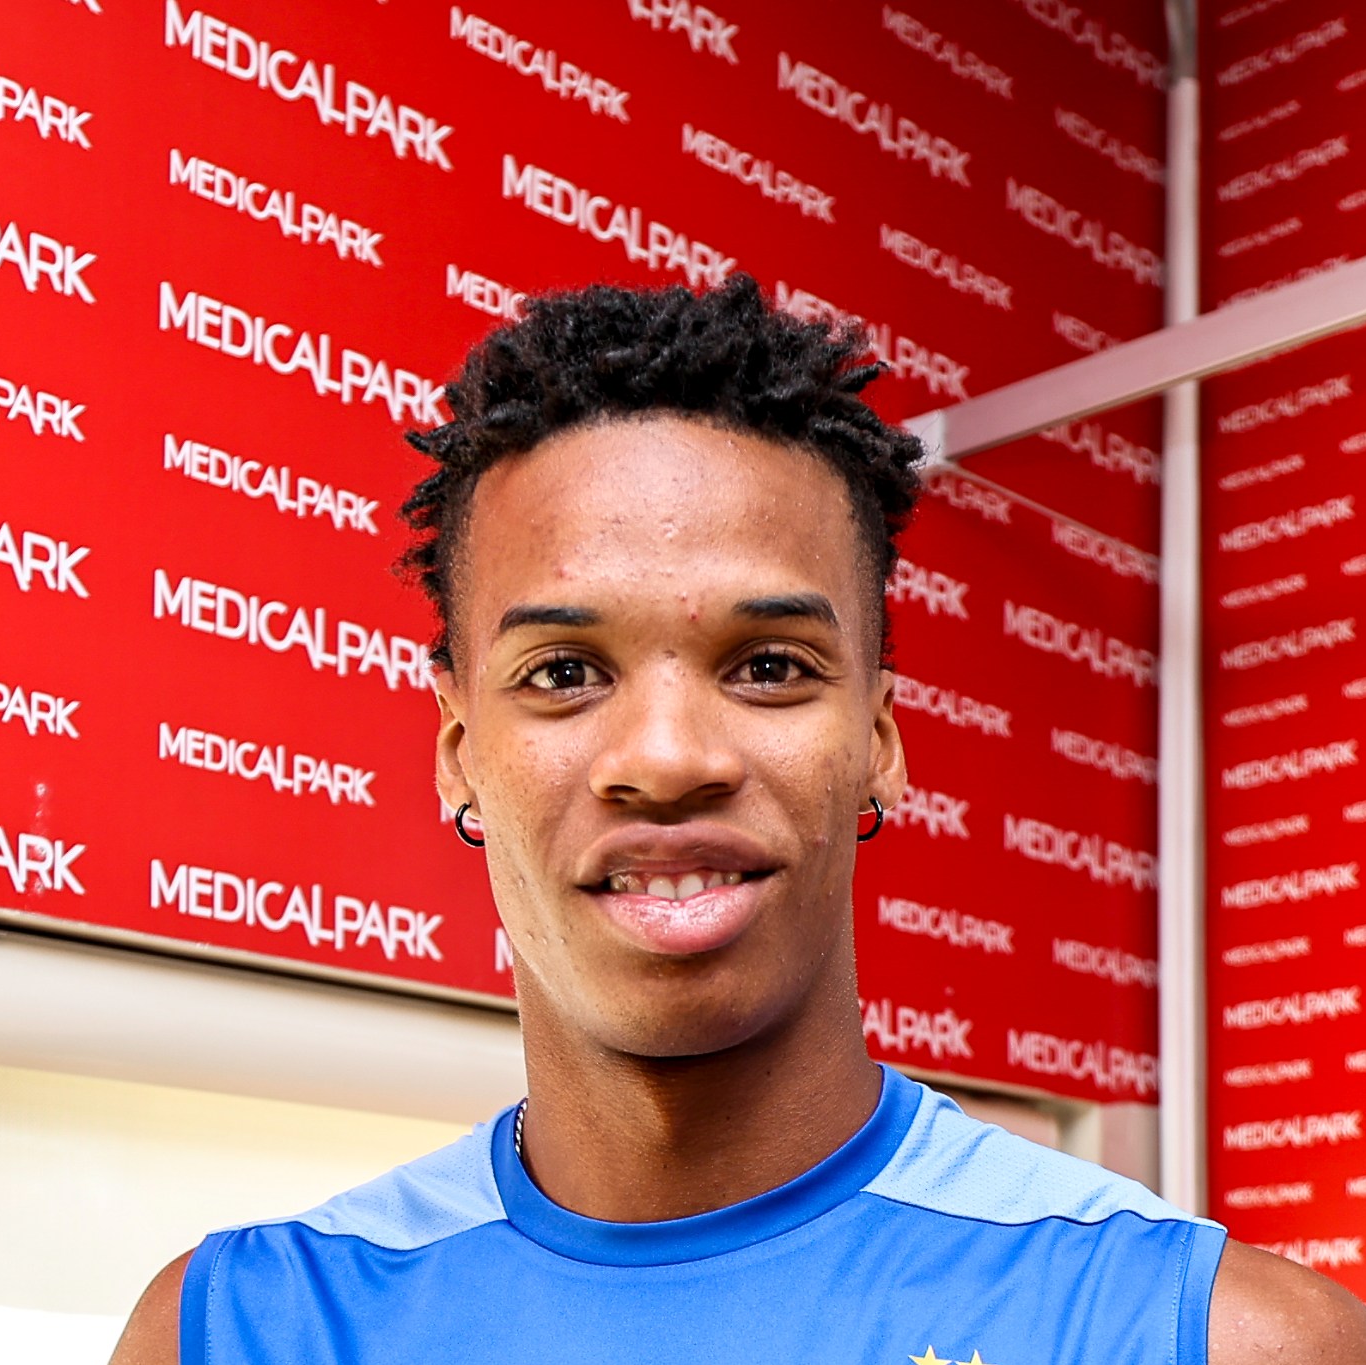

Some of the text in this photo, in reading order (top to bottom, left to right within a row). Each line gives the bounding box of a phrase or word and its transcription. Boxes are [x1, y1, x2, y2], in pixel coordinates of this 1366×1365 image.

[164, 0, 453, 171] MEDICALPARK
[449, 6, 630, 122] MEDICALPARK
[777, 51, 970, 187] MEDICALPARK
[169, 148, 383, 266] MEDICALPARK
[681, 122, 835, 224] MEDICALPARK
[159, 282, 448, 428] MEDICALPARK
[163, 433, 379, 535] MEDICALPARK
[893, 673, 1012, 739] EDICALPARK
[159, 722, 375, 806] MEDICALPARK
[150, 859, 443, 961] MEDICALPARK
[877, 895, 1014, 954] MEDICALPARK
[859, 998, 974, 1058] ALPARK
